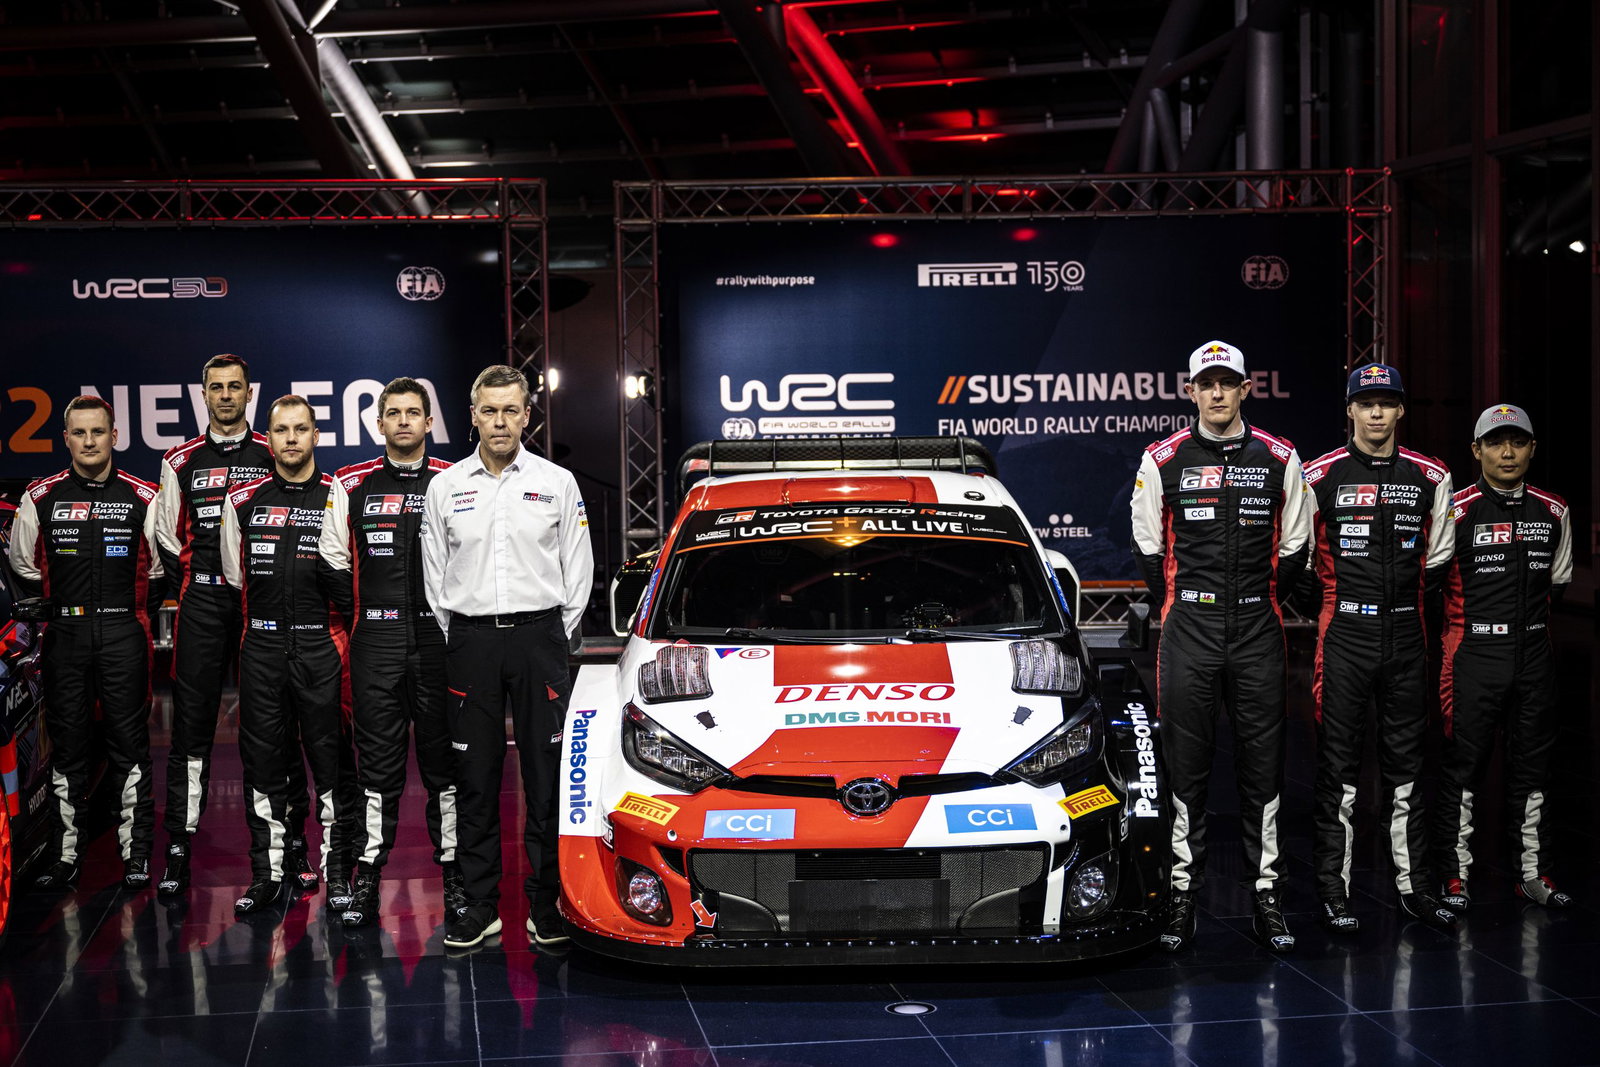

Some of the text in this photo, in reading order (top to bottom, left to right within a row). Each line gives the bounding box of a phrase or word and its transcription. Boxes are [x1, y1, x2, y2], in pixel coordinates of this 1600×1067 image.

[917, 262, 1018, 287] PIRELLI
[1027, 260, 1085, 292] 150
[715, 274, 815, 288] #rallywithpurpose
[73, 278, 169, 299] WRC
[1201, 354, 1231, 365] Red Bull
[1360, 376, 1391, 387] Red Bull
[720, 372, 895, 412] WRC
[788, 421, 838, 429] WORLD
[842, 420, 891, 428] RALLY
[1491, 415, 1505, 424] Red
[938, 418, 968, 436] FIA
[972, 417, 1039, 436] WORLD
[1044, 416, 1099, 434] RALLY
[1154, 446, 1174, 462] OMP
[1271, 443, 1289, 460] OMP
[230, 466, 270, 474] TOYOTA
[1227, 465, 1270, 474] TOYOTA
[1225, 472, 1266, 480] GAZOO
[1305, 469, 1324, 483] OMP
[1426, 468, 1444, 482] OMP
[1224, 479, 1265, 489] Racing
[1381, 483, 1422, 493] TOYOTA
[31, 486, 48, 501] OMP
[136, 487, 154, 502] OMP
[231, 492, 249, 505] OMP
[406, 493, 426, 501] TOY
[1380, 491, 1418, 499] GAZOO
[93, 501, 134, 509] TOYOTA
[454, 497, 475, 506] DENSO
[1240, 497, 1271, 506] DENSO
[1380, 497, 1416, 507] Racing
[90, 513, 127, 521] Racing
[760, 509, 838, 519] TOYOTA
[843, 506, 916, 516] GAZOO
[919, 508, 986, 521] Racing
[1191, 509, 1208, 518] CCi
[1238, 508, 1270, 516] Panasonic
[1394, 513, 1422, 523] DENSO
[861, 519, 906, 532] ALL
[912, 519, 965, 533] LIVE
[1393, 524, 1421, 532] Panasonic
[1516, 521, 1553, 529] TOYOTA
[51, 528, 79, 536] DENSO
[1053, 526, 1093, 538] STEEL
[299, 535, 319, 543] DEN
[1514, 534, 1549, 543] Racing
[1474, 553, 1505, 563] DENSO
[1181, 591, 1198, 600] OMP
[1339, 603, 1359, 612] OMP
[366, 610, 383, 619] OMP
[1471, 625, 1491, 633] OMP
[774, 685, 956, 704] DENSO
[785, 711, 951, 726] DMG MORI
[1124, 701, 1159, 818] Panasonic
[569, 709, 597, 825] Panasonic
[1063, 788, 1114, 815] PIRELLI
[619, 794, 671, 821] PIRELLI
